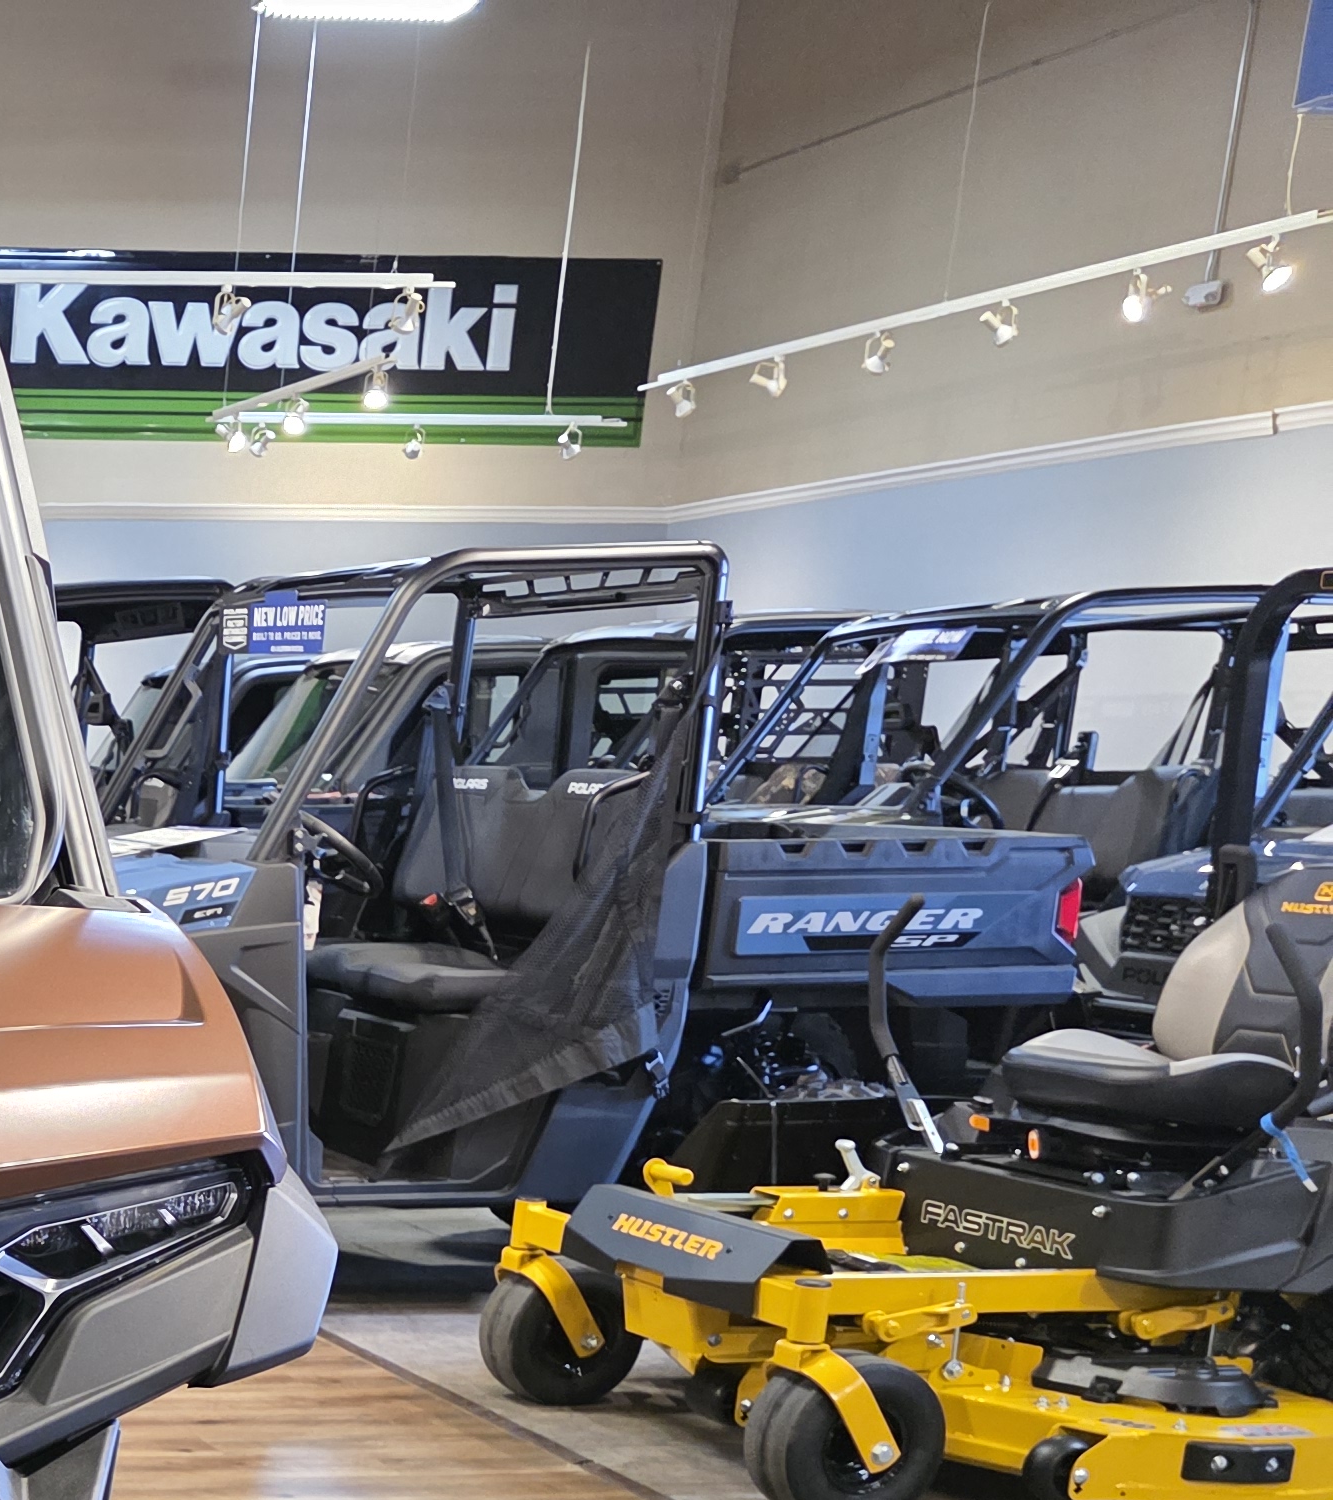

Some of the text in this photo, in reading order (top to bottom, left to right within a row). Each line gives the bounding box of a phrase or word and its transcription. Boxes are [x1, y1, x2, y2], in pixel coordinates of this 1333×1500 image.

[9, 282, 519, 371] Kawasaki
[253, 604, 325, 627] NEW LOW PRICE
[453, 777, 489, 790] OLARIS
[162, 877, 240, 907] 570
[746, 908, 984, 934] RANGER
[1281, 901, 1333, 915] HUSTL
[889, 933, 960, 948] SP
[612, 1212, 724, 1260] HUSTLER
[920, 1199, 1076, 1260] FASTRAK
